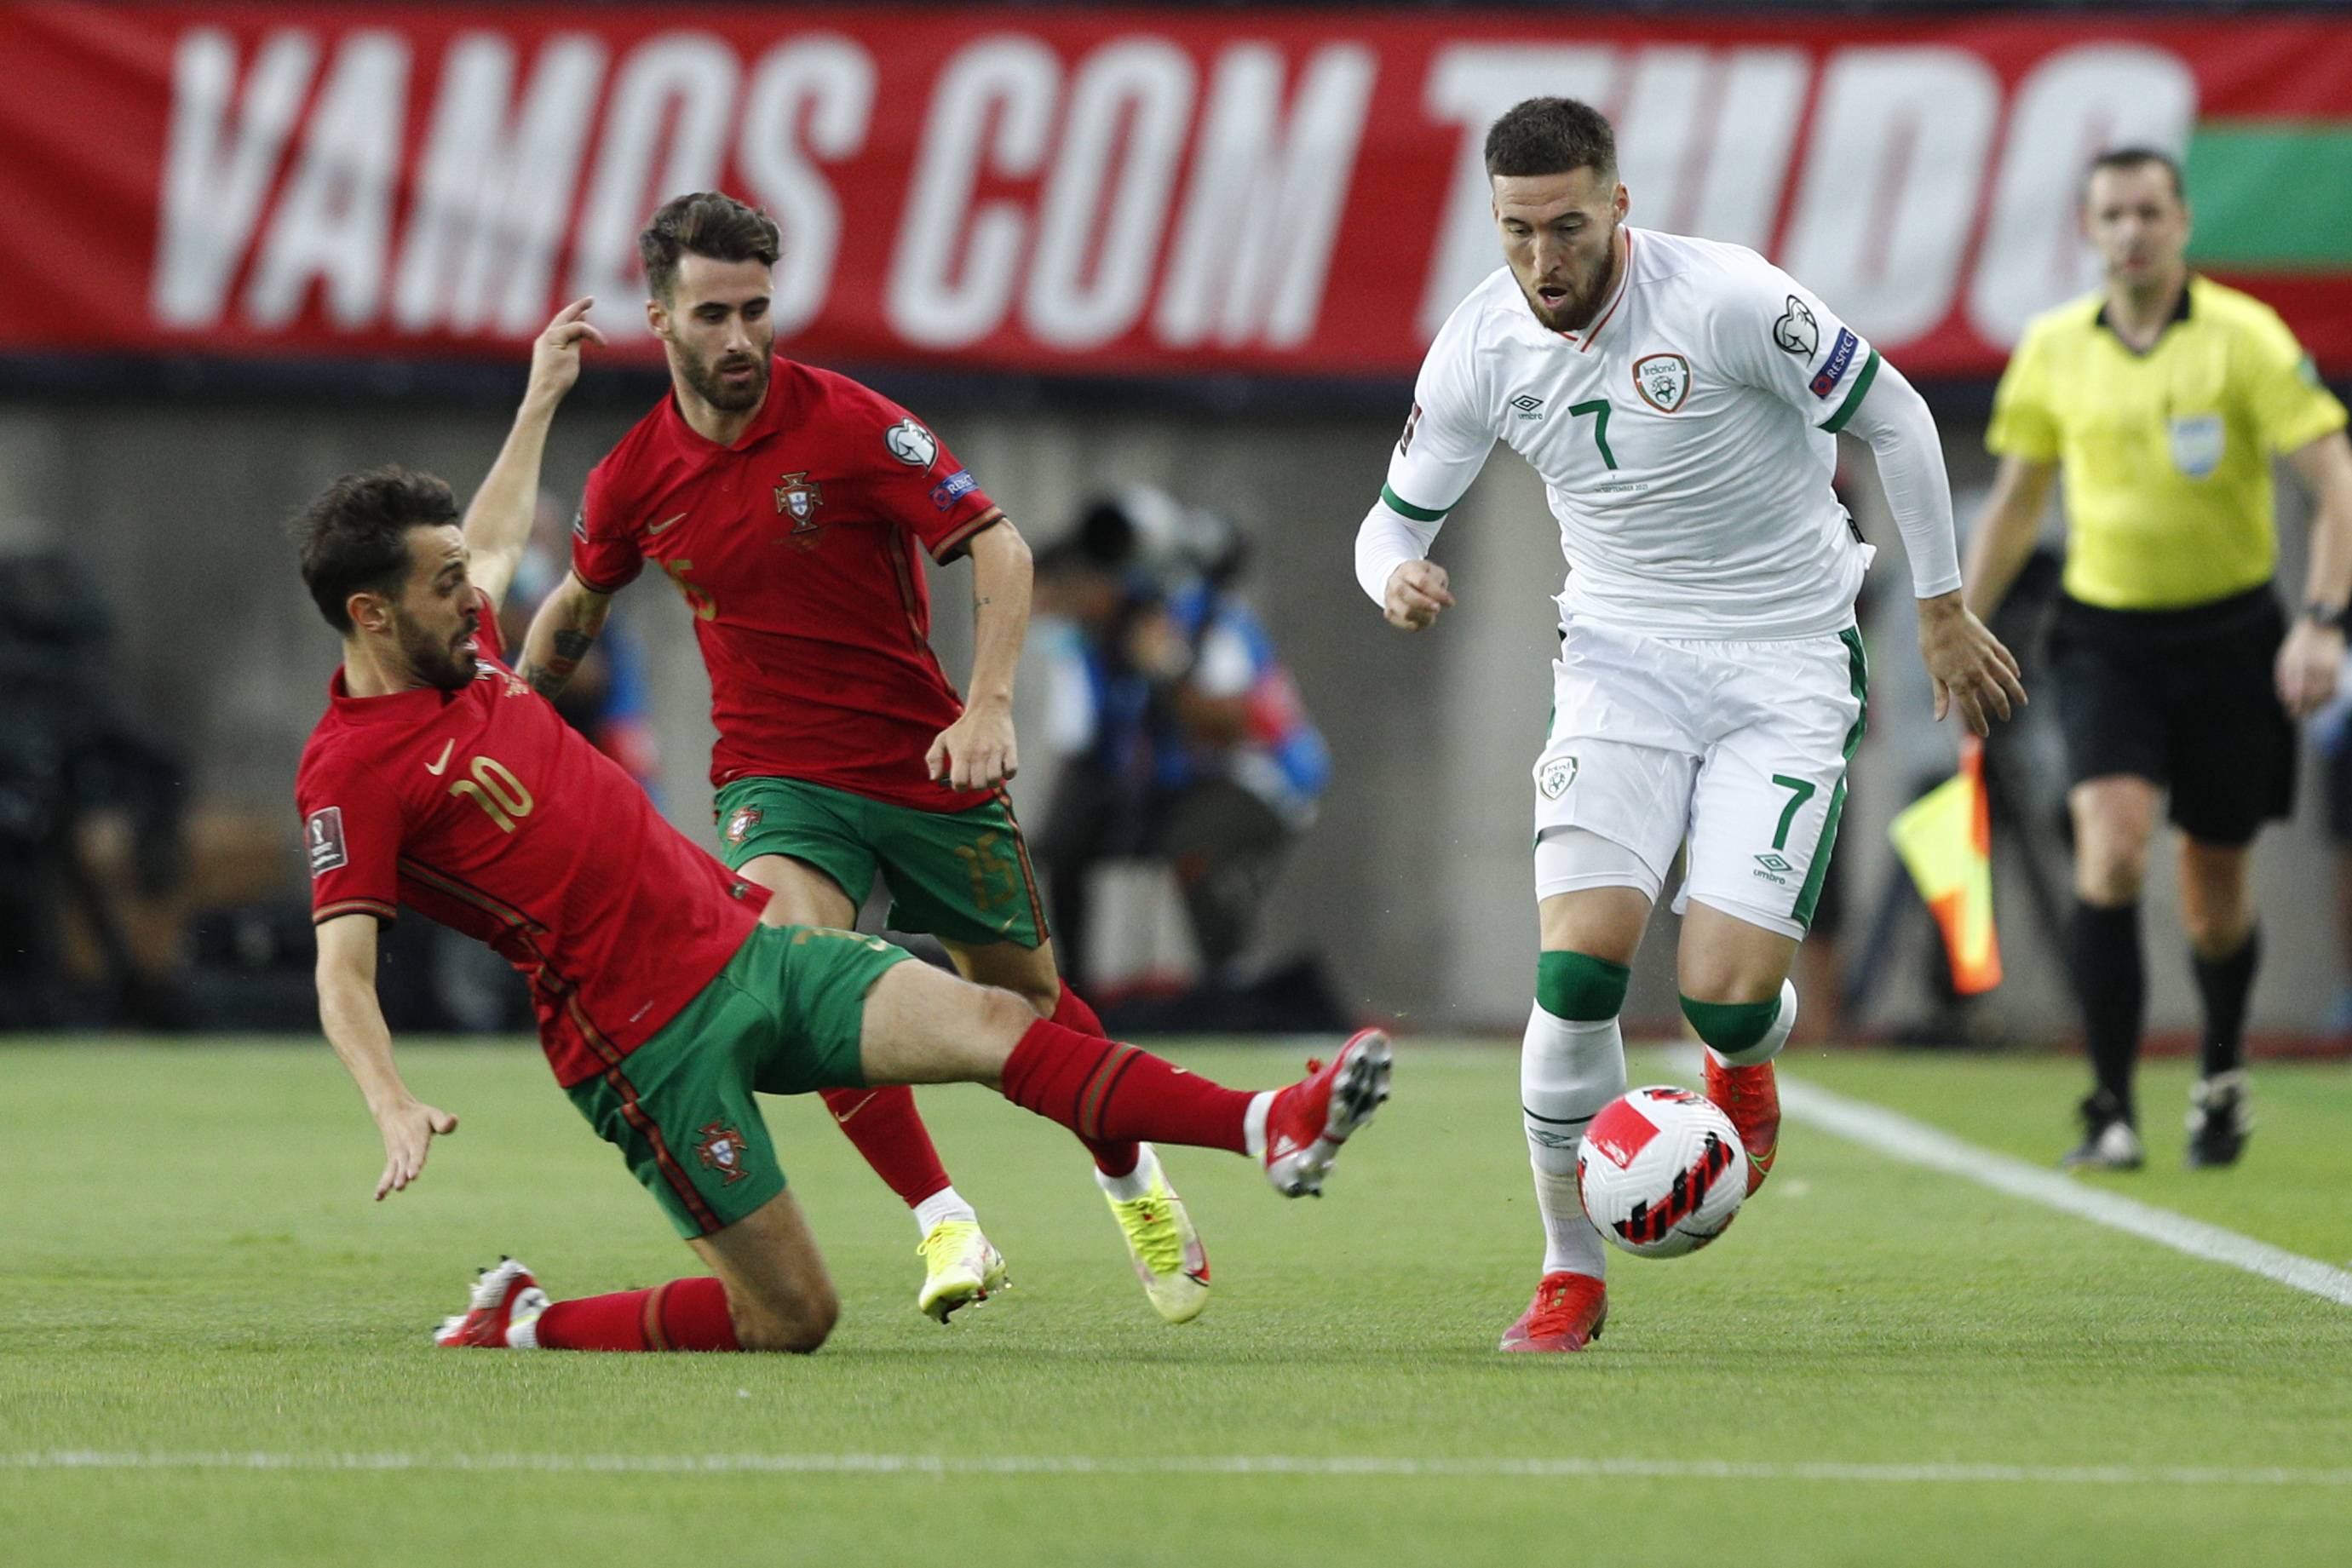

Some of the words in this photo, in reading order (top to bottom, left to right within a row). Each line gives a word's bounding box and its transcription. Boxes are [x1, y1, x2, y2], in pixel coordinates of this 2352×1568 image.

[152, 26, 879, 339] VAMOS
[883, 32, 1380, 349] COM
[1416, 37, 2201, 349] TUDO
[1826, 331, 1855, 379] RESPECT
[1567, 399, 1618, 470] 7
[448, 755, 533, 834] 10
[1772, 773, 1816, 852] 7
[953, 830, 1017, 911] 15
[1753, 869, 1786, 885] umbro
